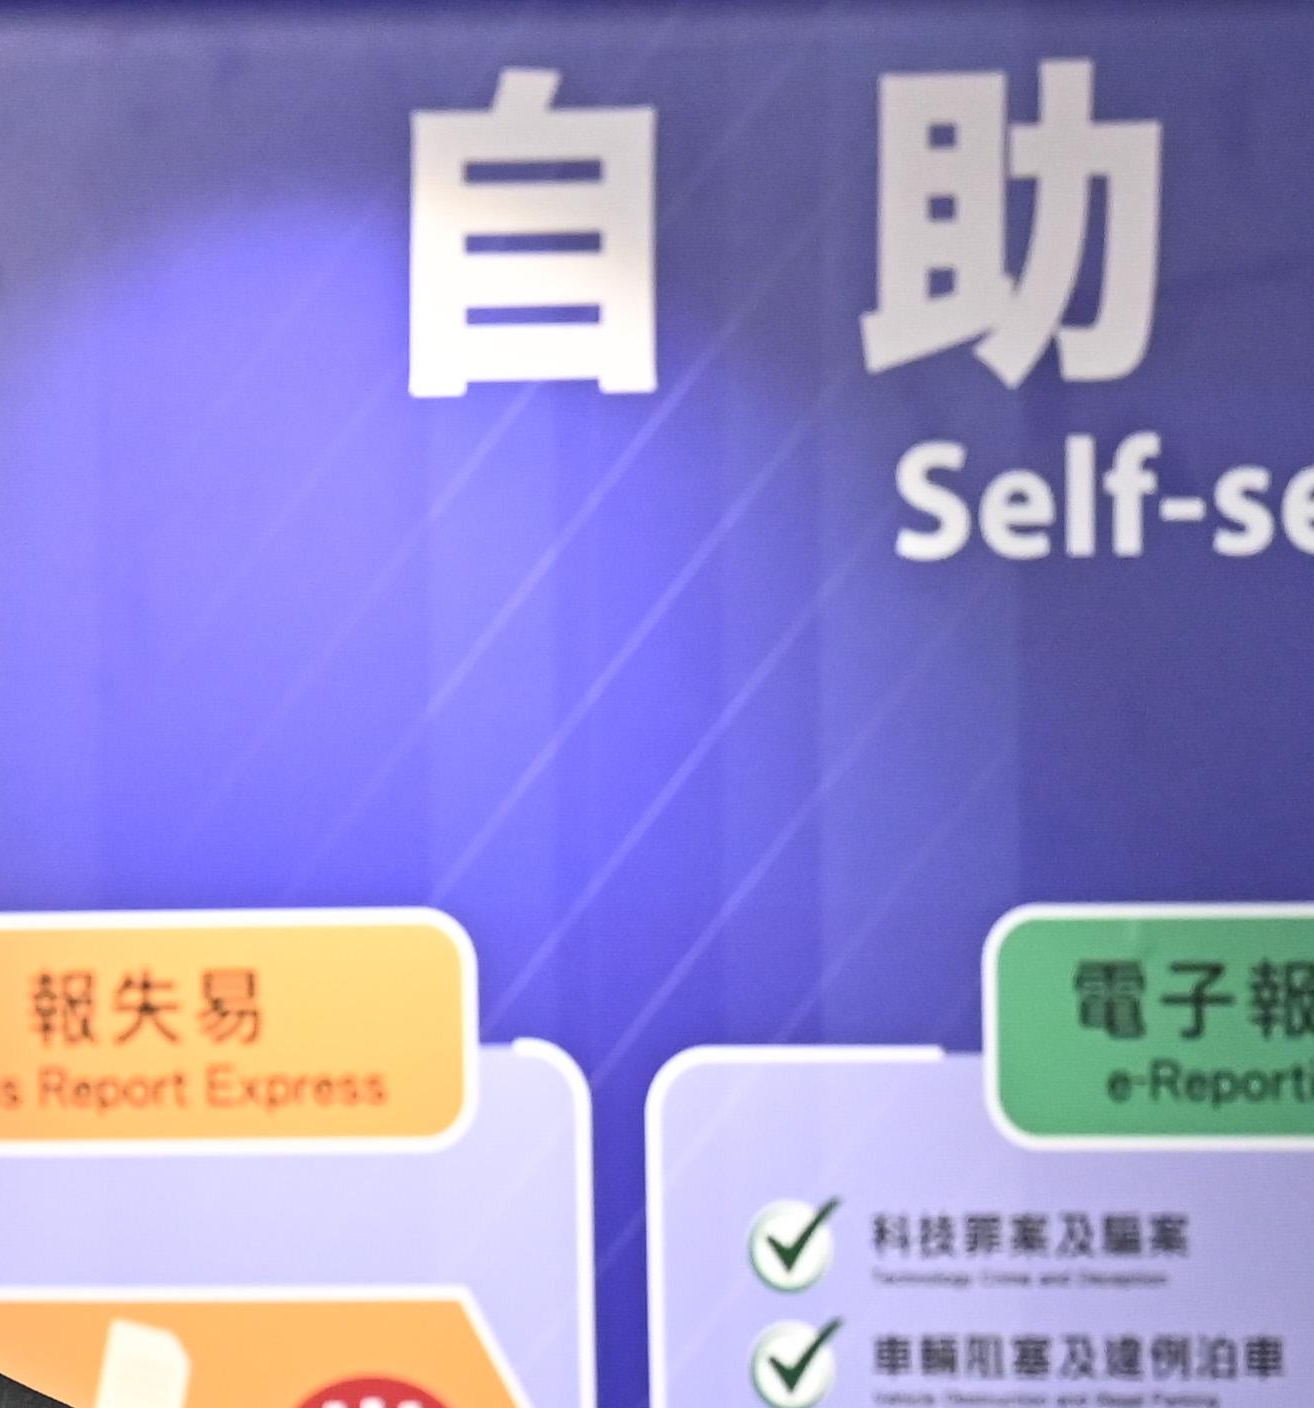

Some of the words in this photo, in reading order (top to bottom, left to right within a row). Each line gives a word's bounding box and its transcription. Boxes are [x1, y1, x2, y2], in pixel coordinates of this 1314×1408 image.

[409, 57, 1163, 398] 自助
[29, 967, 263, 1046] 報失易
[1075, 957, 1314, 1041] 電子報
[38, 1064, 186, 1115] Report
[206, 1062, 388, 1114] Express
[874, 1213, 1189, 1257] 科技罪案及騙案
[875, 1336, 1284, 1379] 車輛阻塞及違例泊車
